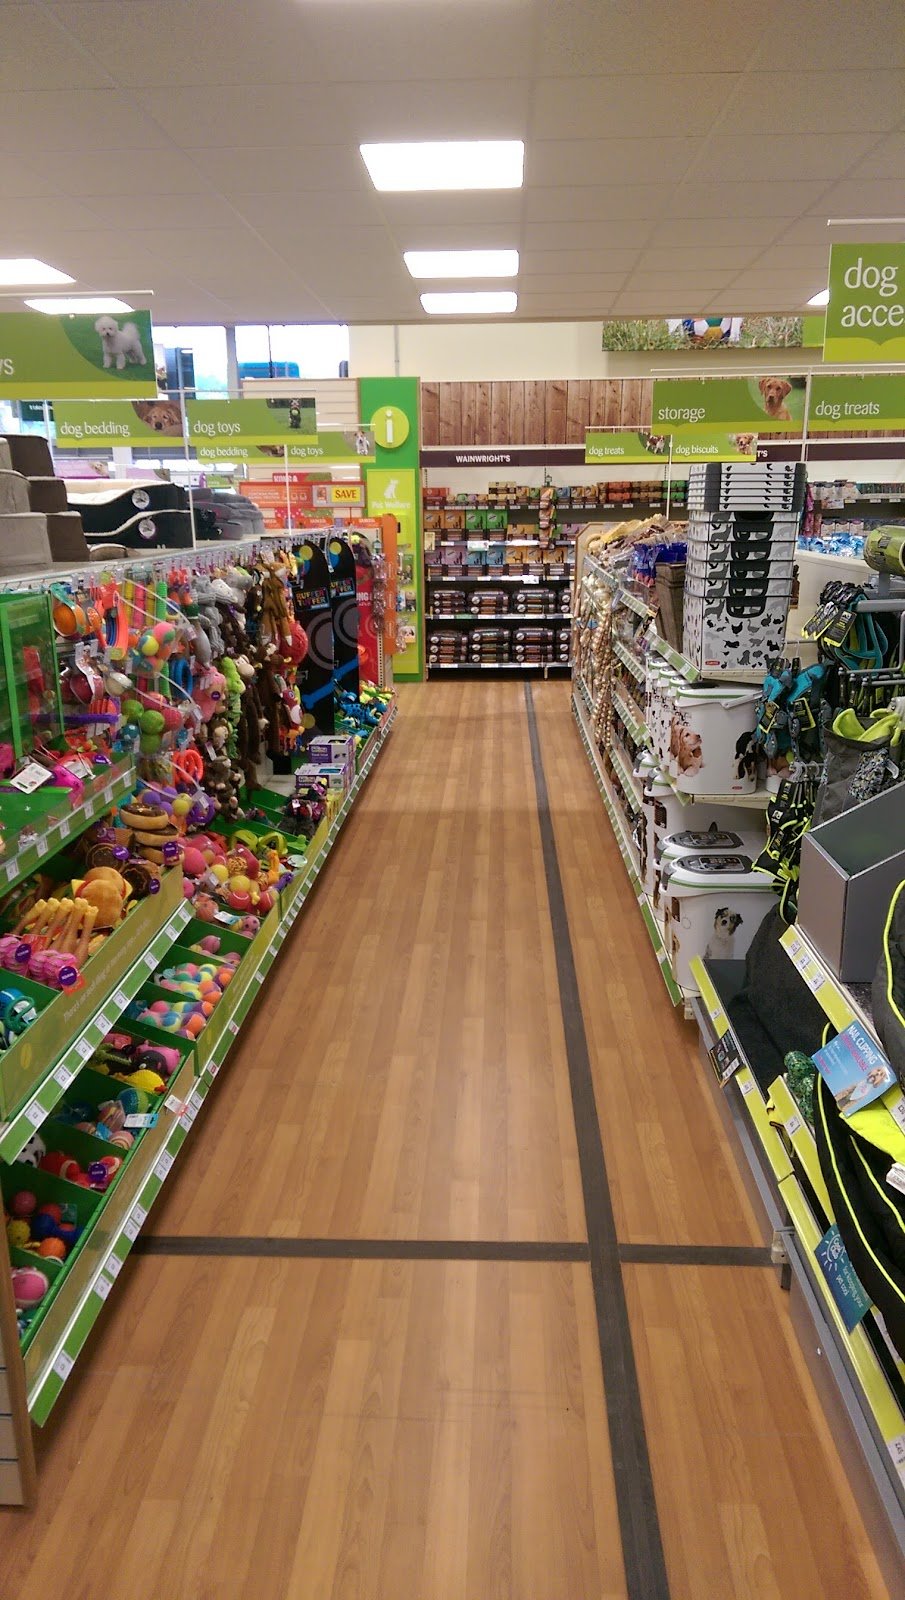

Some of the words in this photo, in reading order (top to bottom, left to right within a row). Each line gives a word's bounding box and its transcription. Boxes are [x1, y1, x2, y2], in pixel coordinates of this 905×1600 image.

[844, 257, 898, 297] dog
[841, 304, 904, 327] acce
[658, 406, 705, 423] storage
[815, 400, 840, 419] dog
[844, 401, 880, 415] treats
[60, 421, 83, 438] dog
[84, 421, 130, 437] bedding
[193, 420, 215, 436] dog
[217, 421, 240, 436] toys
[200, 446, 215, 458] dog
[216, 446, 248, 457] bedding
[290, 446, 306, 457] dog
[307, 446, 324, 456] toys
[589, 445, 603, 456] dog
[604, 445, 624, 455] treats
[675, 444, 691, 456] dog
[691, 443, 718, 454] biscuits
[455, 454, 511, 463] WAINWRIGHT'S
[335, 489, 357, 499] SAVE
[847, 1024, 860, 1041] NAIL
[856, 1037, 877, 1064] CLIPPING
